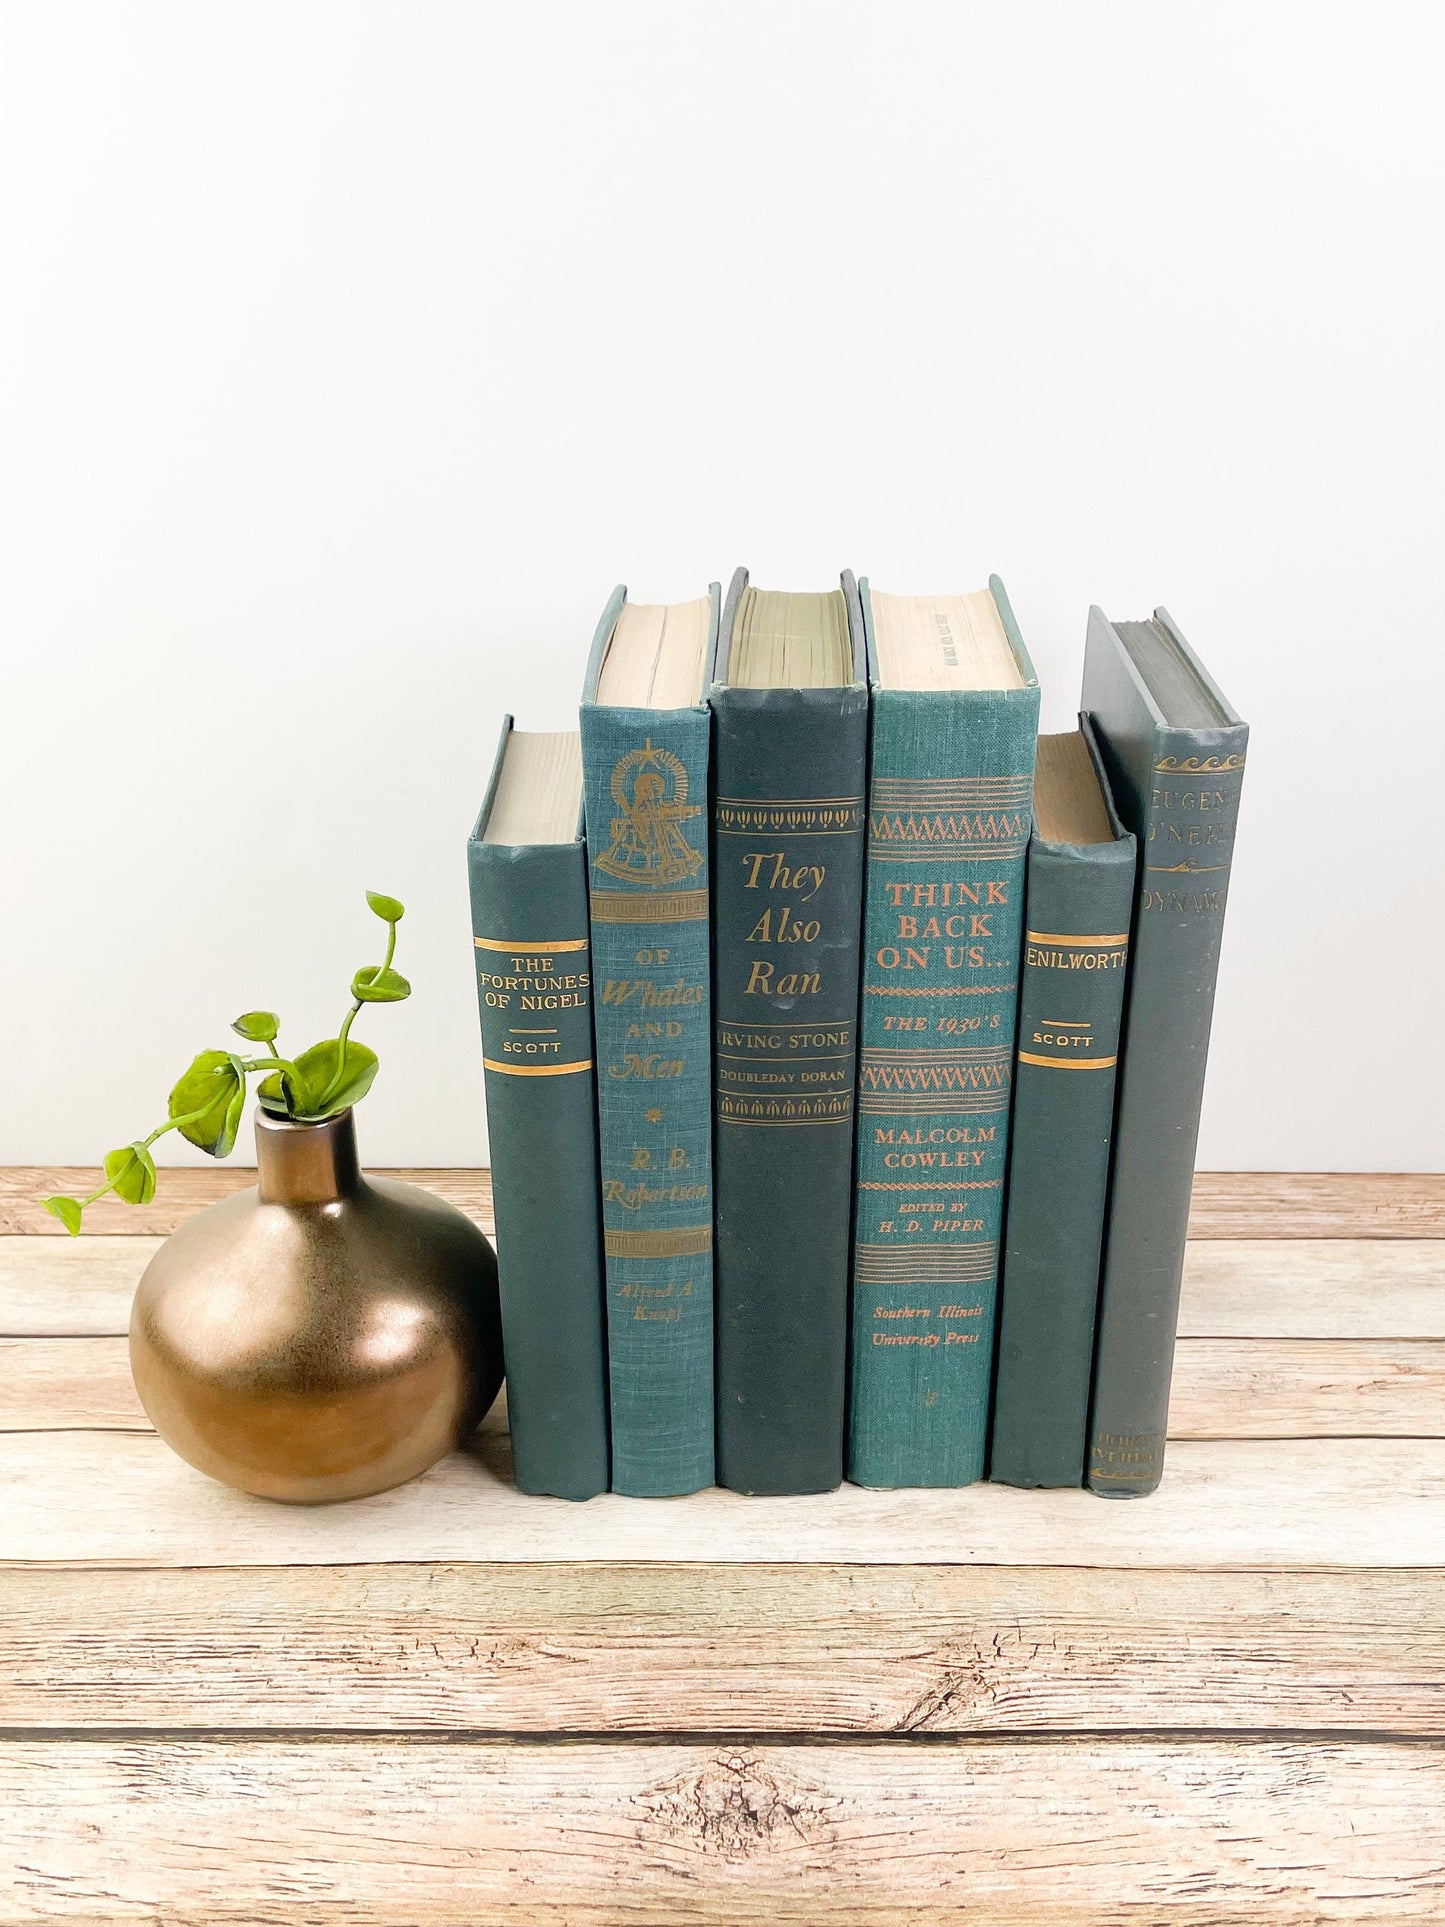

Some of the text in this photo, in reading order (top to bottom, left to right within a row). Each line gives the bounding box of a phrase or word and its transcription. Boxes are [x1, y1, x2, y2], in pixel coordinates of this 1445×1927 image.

[1148, 822, 1233, 845] O'NEIL
[742, 852, 826, 902] They
[886, 881, 1008, 906] THINK
[745, 907, 822, 943] Also
[897, 914, 993, 939] BACK
[510, 958, 554, 973] THE
[635, 949, 671, 966] OF
[876, 946, 1011, 969] ON US...
[1027, 947, 1128, 970] ENILWORTH
[480, 972, 590, 991] FORTUNES
[744, 961, 822, 995] Ran
[484, 992, 588, 1010] OF NIGEL
[602, 978, 704, 1008] Whales
[626, 1021, 683, 1038] AND
[883, 1013, 1001, 1034] THE 1930'S
[502, 1041, 562, 1054] SCOTT
[789, 1031, 850, 1049] STONE
[1032, 1032, 1094, 1047] SCOTT
[608, 1053, 685, 1080] Men
[720, 1069, 846, 1083] DOUBLEDAY DORAN
[874, 1126, 997, 1145] MALCOLM
[631, 1148, 691, 1170] R. B.
[884, 1151, 986, 1169] COWLEY
[604, 1180, 708, 1210] Robertson
[898, 1202, 968, 1213] EDITED BY
[878, 1219, 984, 1233] H. D. PIPER
[873, 1304, 983, 1319] Southern Illinois
[872, 1331, 980, 1348] University Press
